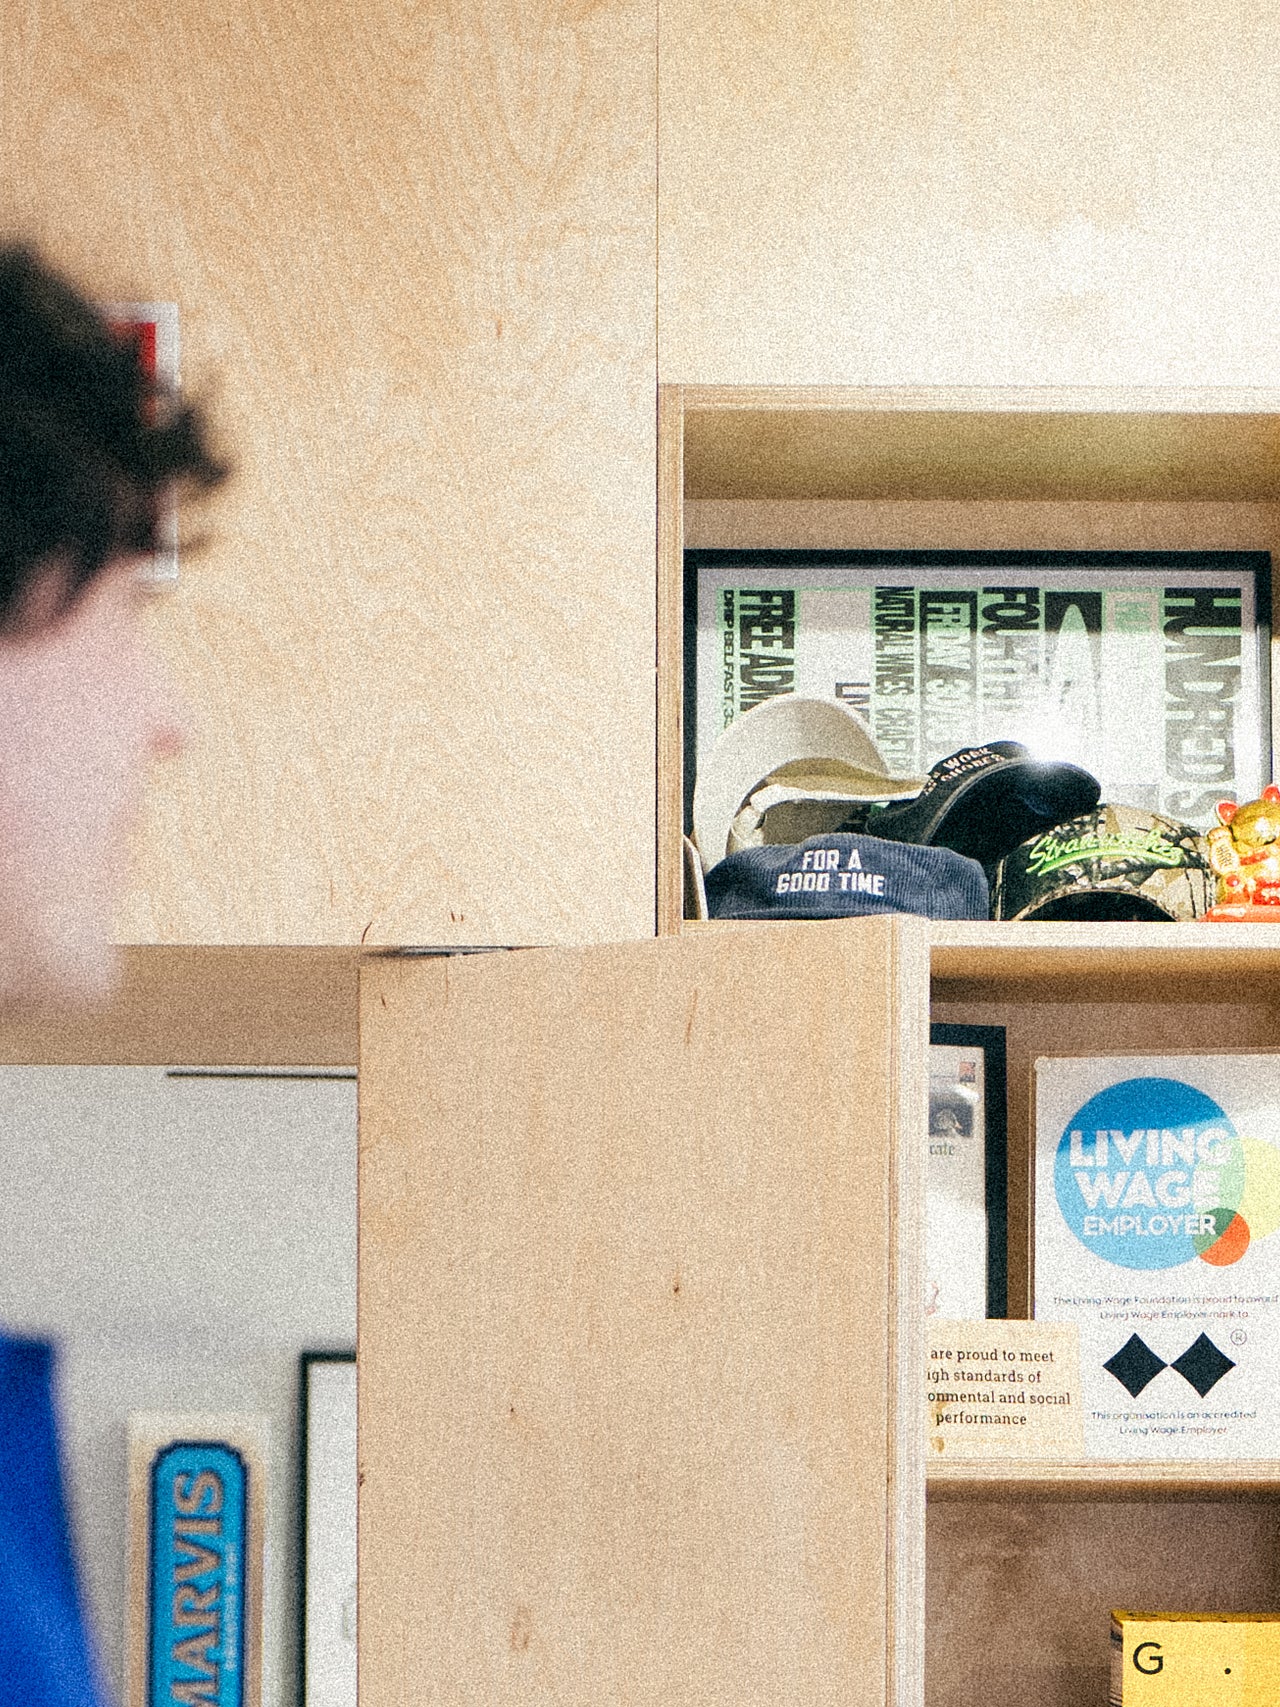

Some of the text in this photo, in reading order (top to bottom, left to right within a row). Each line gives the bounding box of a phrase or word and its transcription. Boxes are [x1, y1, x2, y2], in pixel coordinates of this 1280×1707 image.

[739, 589, 796, 650] FREE
[802, 848, 862, 871] FOR A
[776, 872, 886, 896] GOOD TIME
[1069, 1128, 1233, 1167] LIVING
[1075, 1171, 1224, 1209] WAGE
[1083, 1214, 1216, 1236] EMPLOYER
[931, 1348, 1054, 1364] are proud to meet
[953, 1370, 1024, 1383] standards
[1028, 1370, 1042, 1383] of
[999, 1391, 1025, 1404] and
[1029, 1392, 1070, 1406] social
[936, 1412, 1027, 1427] performance
[1132, 1641, 1165, 1675] G
